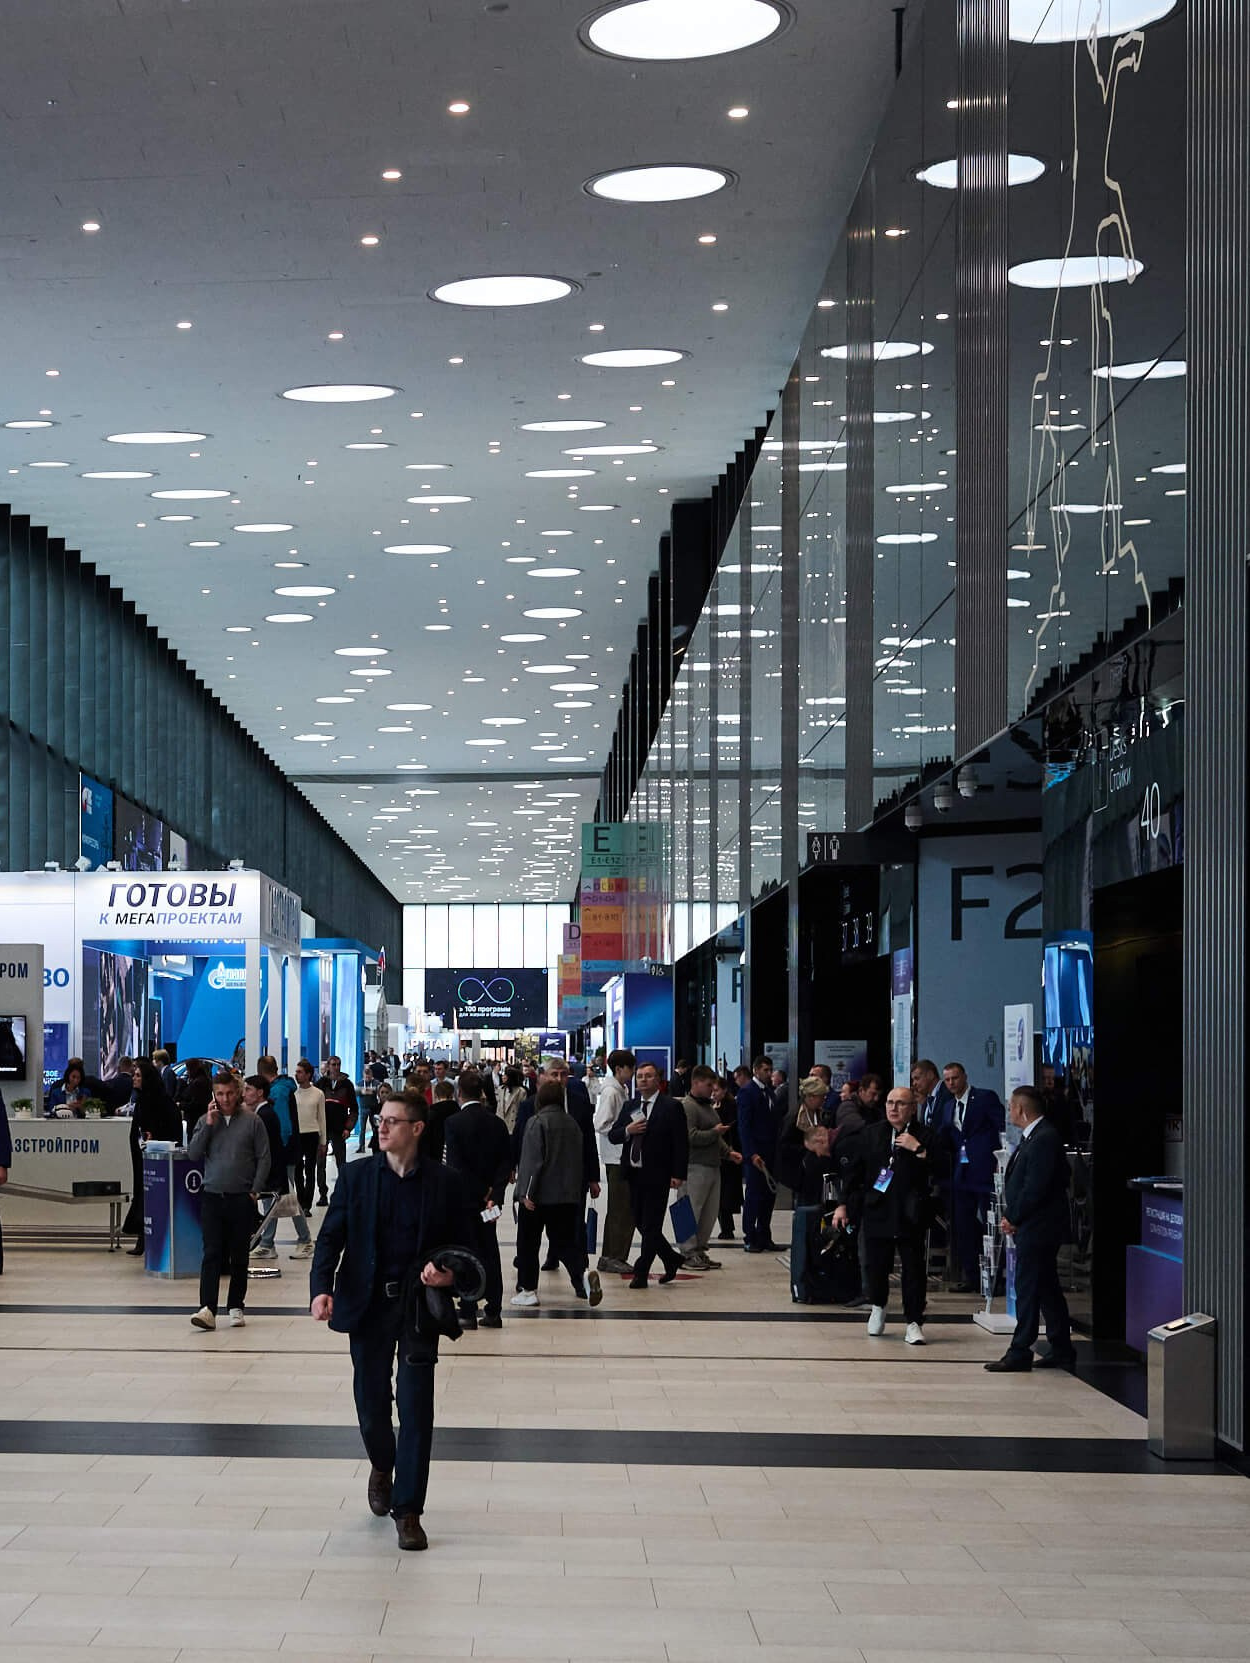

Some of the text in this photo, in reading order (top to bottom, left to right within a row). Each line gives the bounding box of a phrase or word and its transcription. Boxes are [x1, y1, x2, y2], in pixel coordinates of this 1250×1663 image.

[1141, 782, 1160, 841] 40
[593, 826, 610, 852] E
[108, 883, 237, 908] ГОТОВЫ
[951, 862, 1043, 941] F2
[99, 912, 242, 925] К МЕГАПРОЕКТАМ
[568, 924, 581, 940] D
[12, 1136, 100, 1154] ЗСТРОЙПРОМ
